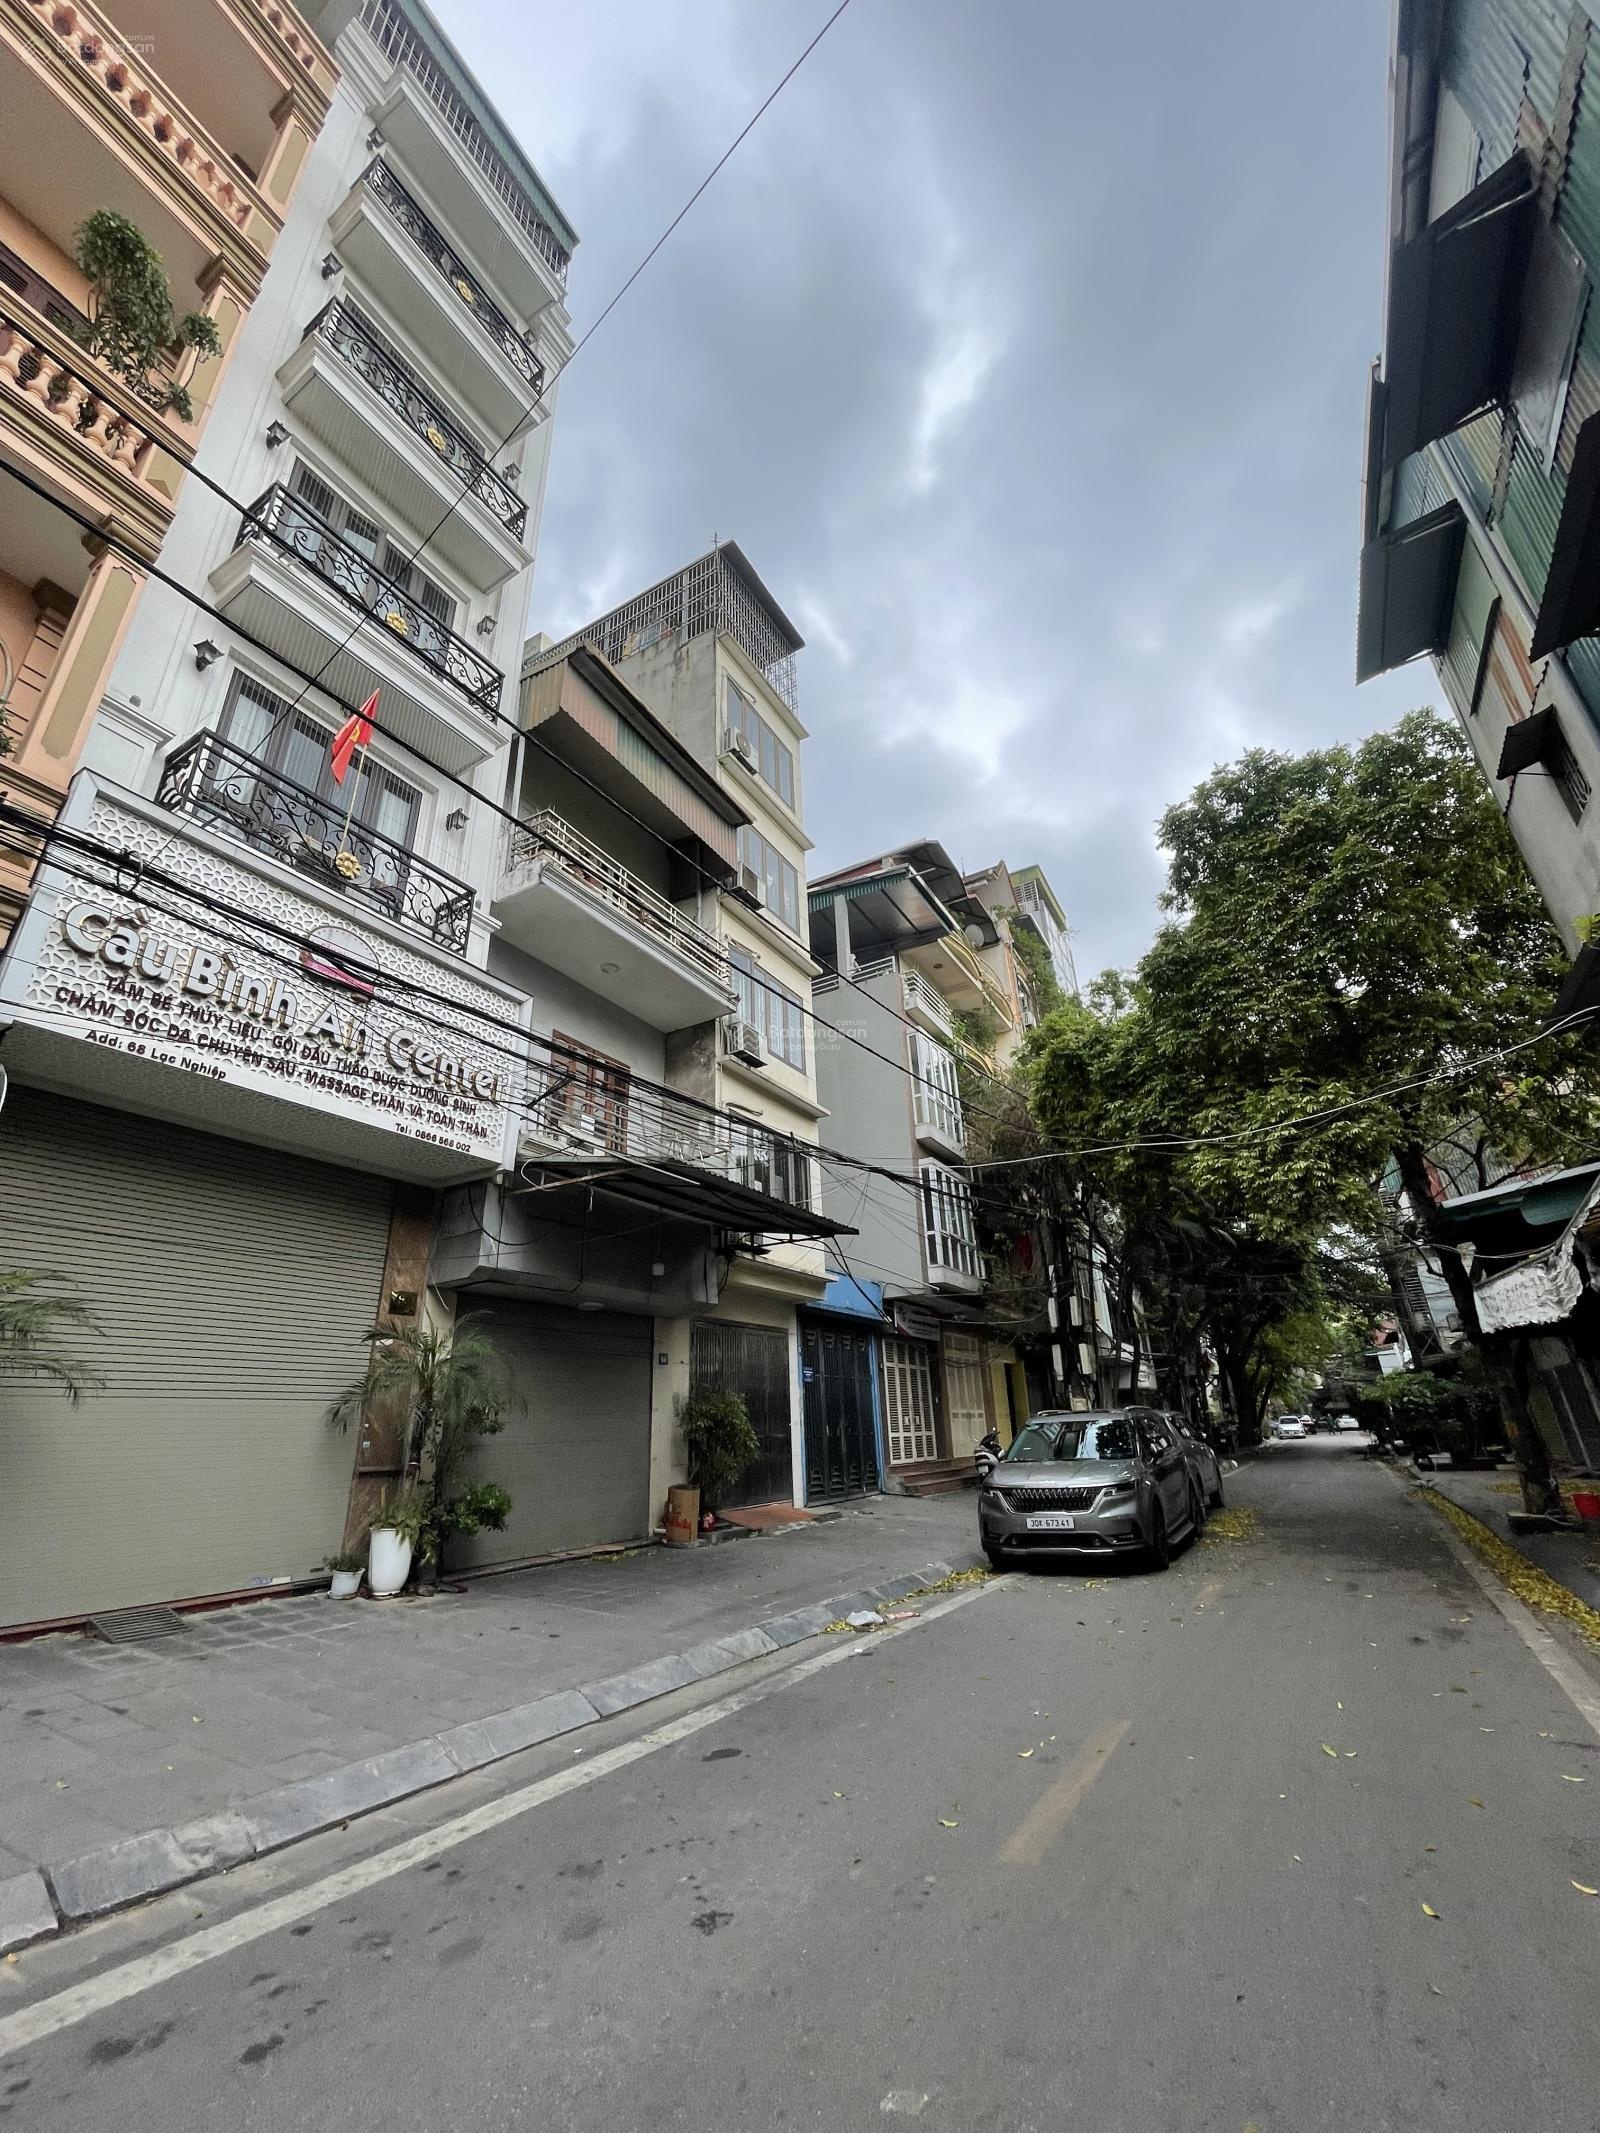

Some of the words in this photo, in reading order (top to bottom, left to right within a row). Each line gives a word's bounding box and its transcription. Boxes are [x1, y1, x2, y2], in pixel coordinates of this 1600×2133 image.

[55, 986, 117, 1019] CHĂM
[124, 1009, 160, 1032] SÓC
[167, 1023, 191, 1042] DA
[198, 1034, 263, 1067] CHUYÊN
[267, 1056, 296, 1077] SÂU
[305, 1069, 368, 1100] MASSAGE
[371, 1090, 405, 1114] CHÂN
[409, 1102, 423, 1119] VÀ
[427, 1109, 456, 1130] TOÀN
[460, 1120, 488, 1138] THÂN
[62, 903, 177, 982] Cầu
[183, 947, 298, 1028] Bình
[304, 1000, 374, 1055] An
[385, 1029, 505, 1099] Center
[106, 975, 145, 1000] TẮM
[150, 992, 173, 1011] BÉ
[179, 1001, 223, 1028] THỦY
[228, 1019, 261, 1040] LIỆU
[273, 1035, 298, 1055] GỘI
[453, 1099, 478, 1116] SINH
[127, 1041, 146, 1056] 68
[151, 1047, 176, 1063] Lạc
[181, 1056, 226, 1080] Nghiệp
[456, 1142, 471, 1153] 002
